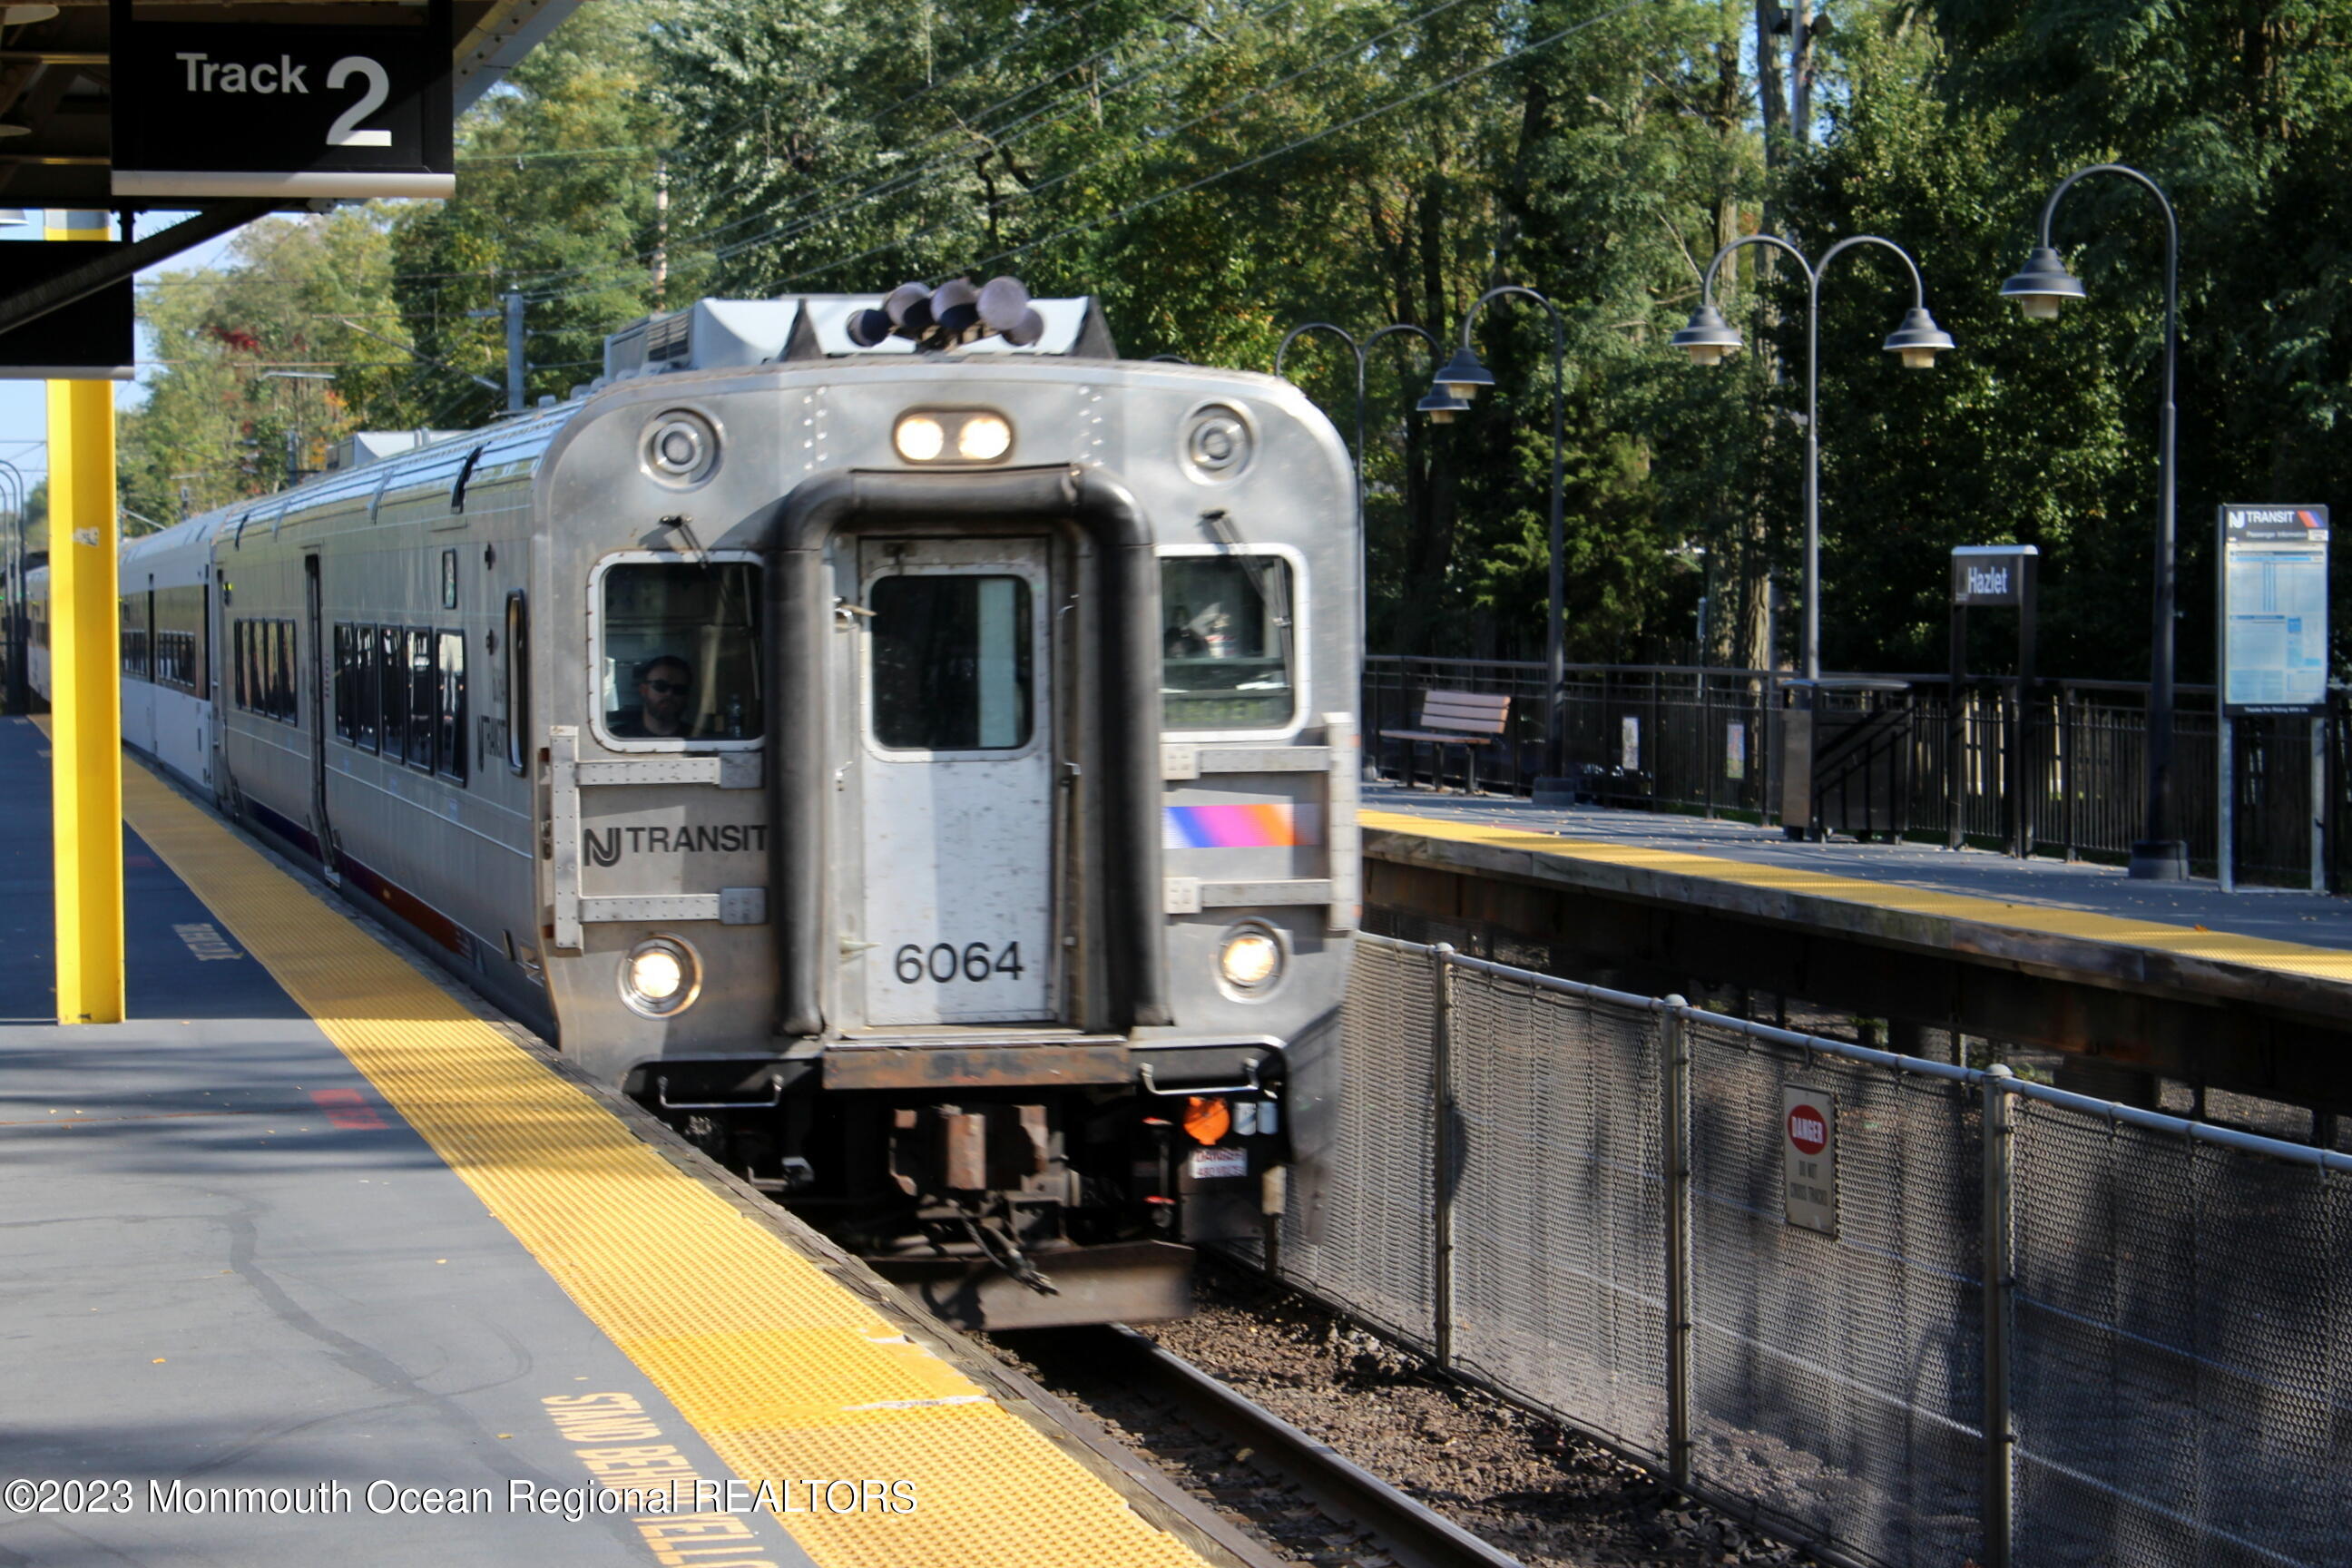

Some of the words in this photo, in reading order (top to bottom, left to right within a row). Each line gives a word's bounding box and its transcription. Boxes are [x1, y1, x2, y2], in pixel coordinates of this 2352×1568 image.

[176, 53, 309, 94] Track
[326, 55, 392, 147] 2
[2228, 511, 2245, 529] NJ
[2246, 510, 2295, 524] TRANSIT
[1967, 566, 2008, 594] Hazlet
[583, 828, 622, 867] NJ
[625, 824, 768, 853] TRANSIT
[896, 941, 1024, 985] 6064
[1791, 1116, 1823, 1144] DANGER
[541, 1392, 662, 1443] STAND
